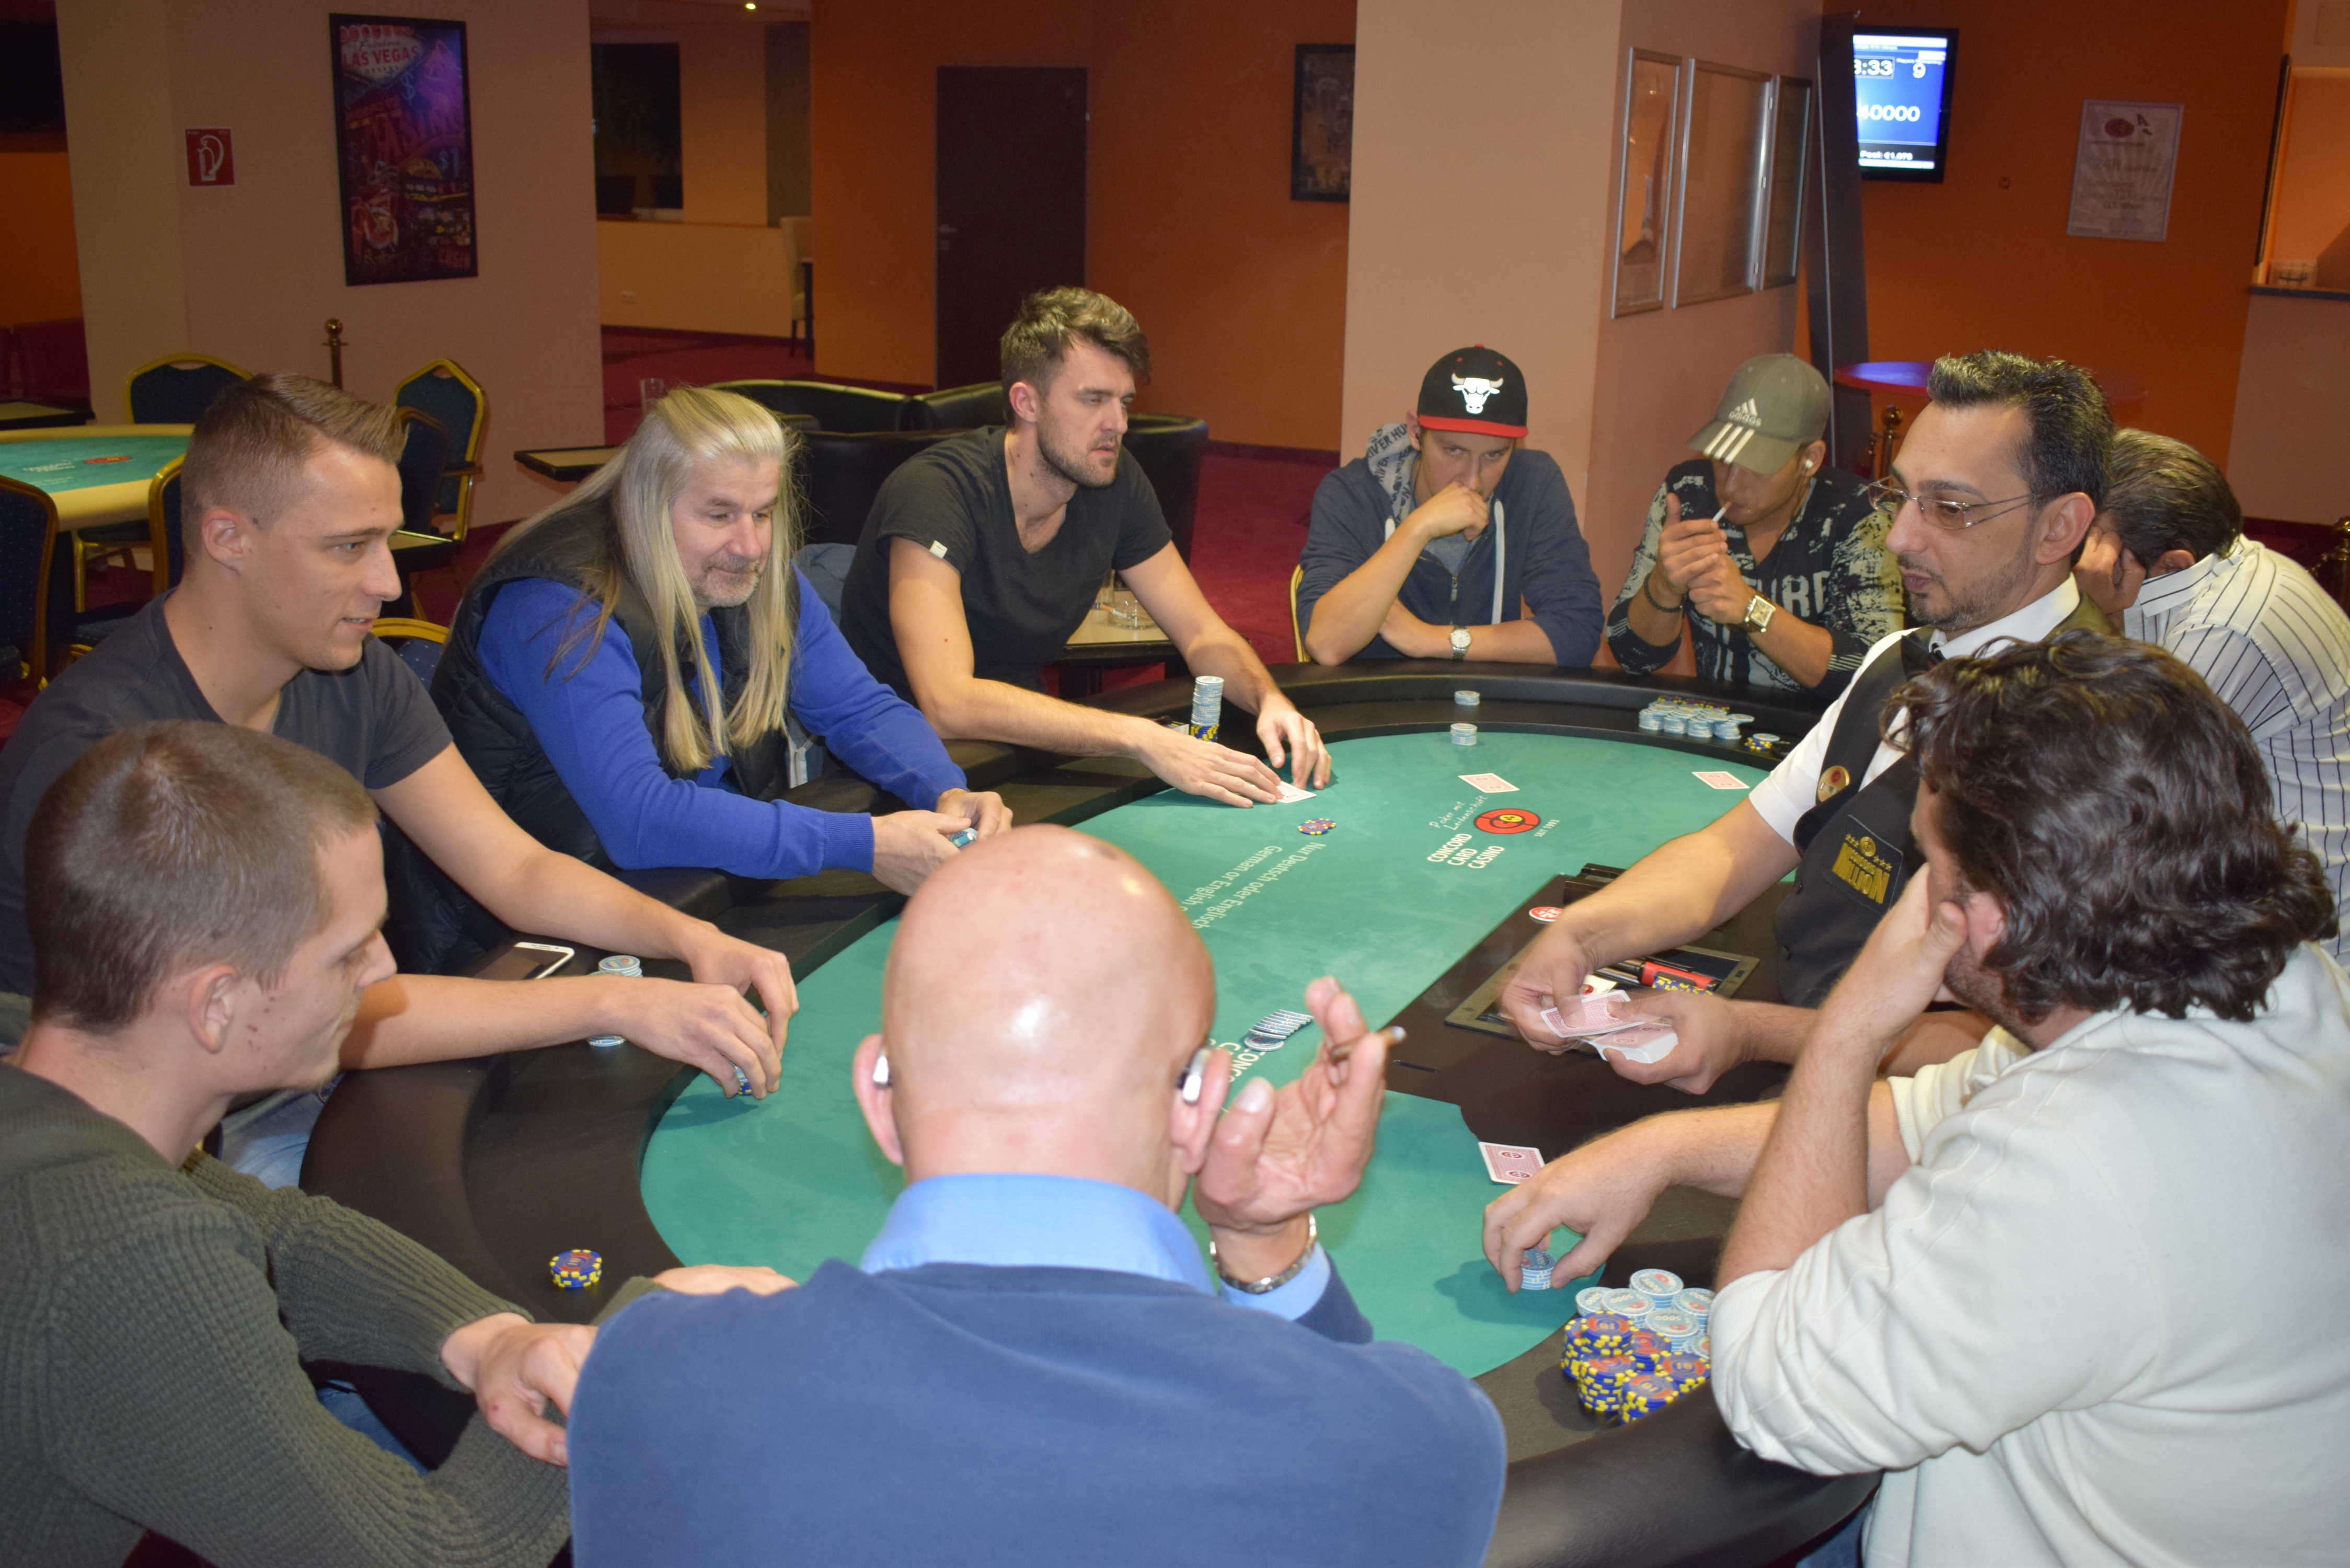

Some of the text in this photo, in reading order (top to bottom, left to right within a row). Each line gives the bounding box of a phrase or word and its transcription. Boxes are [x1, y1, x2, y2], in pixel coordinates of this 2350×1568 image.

[343, 46, 418, 67] LAS VEGAS
[1913, 63, 1926, 78] 9
[1729, 411, 1762, 428] adidas
[1429, 812, 1454, 828] Poker
[1426, 833, 1472, 862] CONCORD
[1447, 848, 1478, 866] CARD
[1467, 846, 1505, 869] CASINO
[1181, 845, 1283, 905] German or English
[1191, 842, 1327, 929] Nur Deutsch oder Englisch
